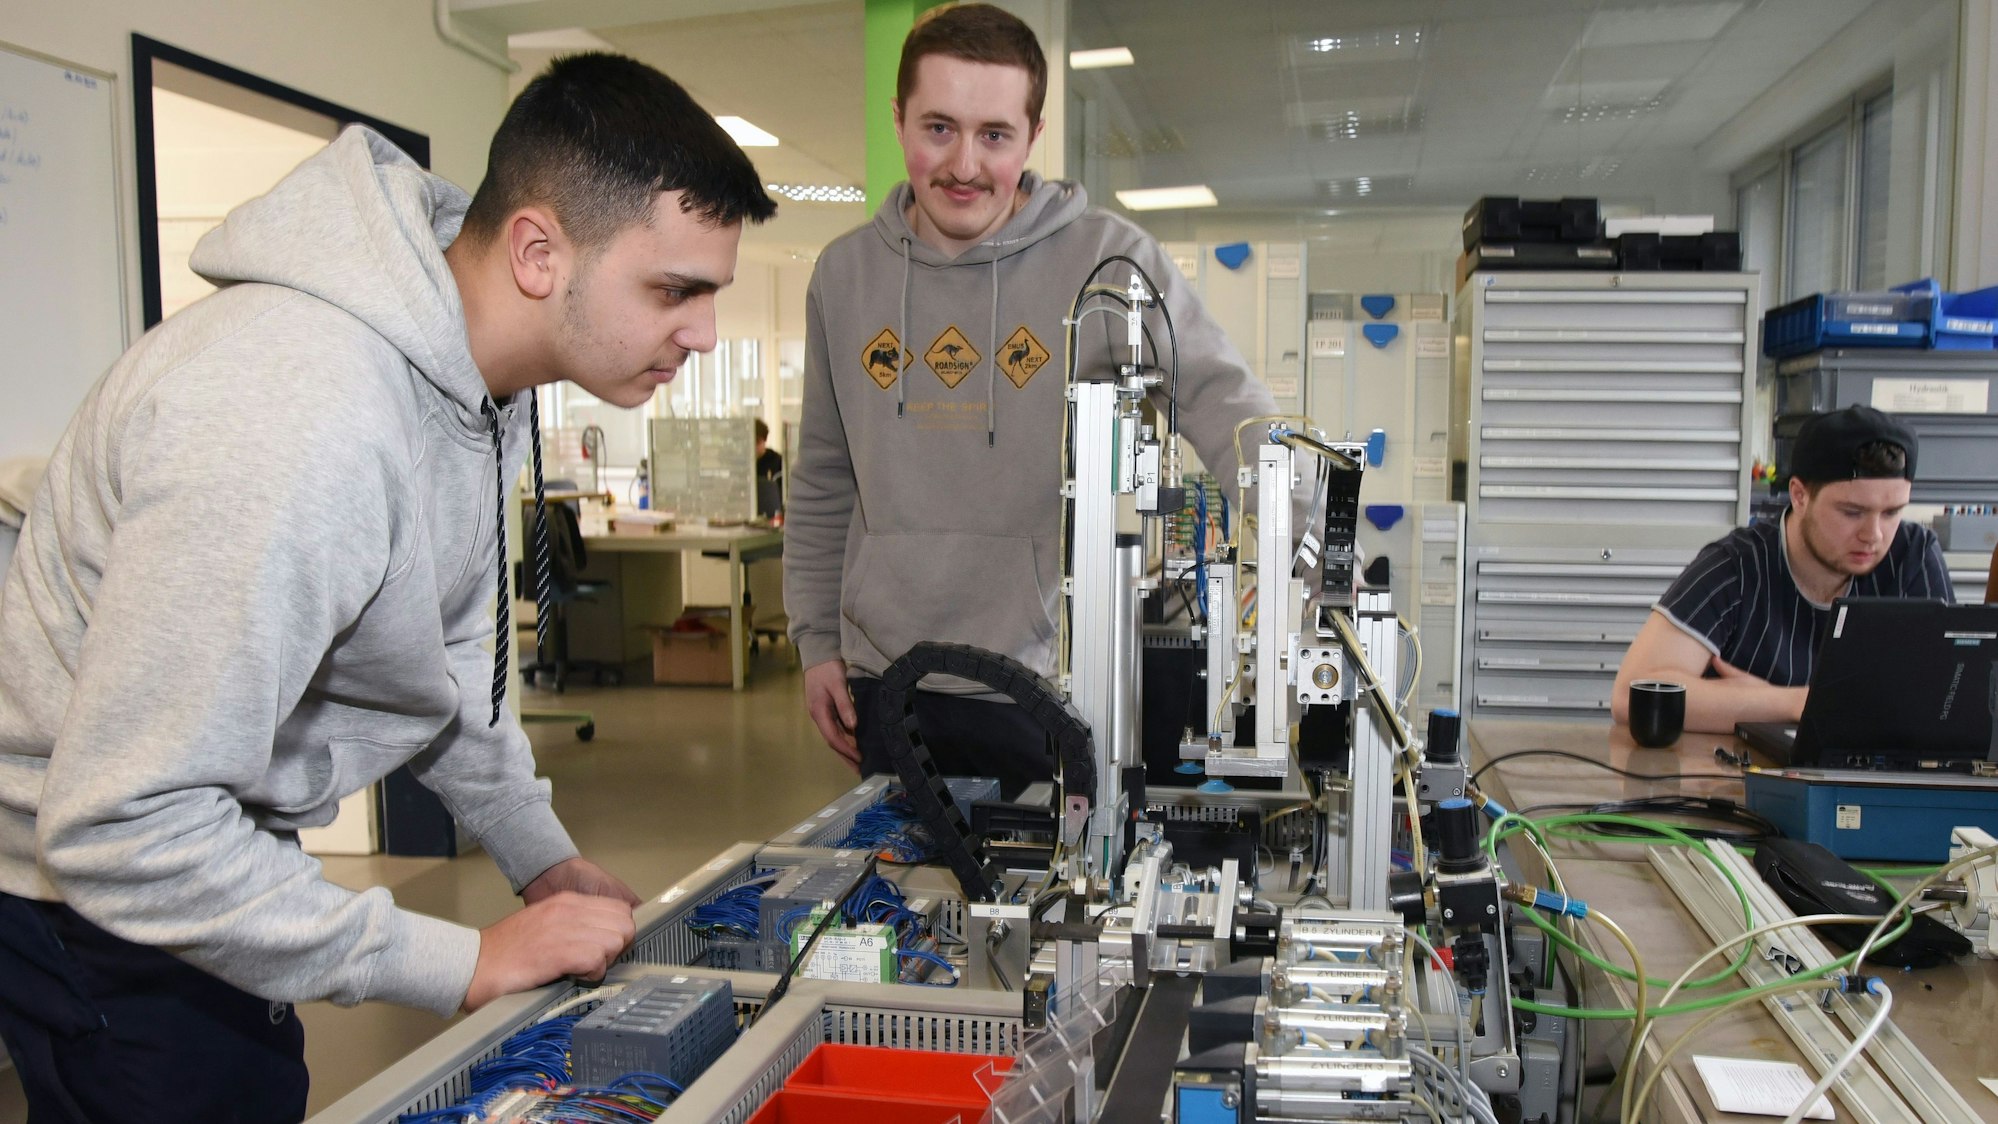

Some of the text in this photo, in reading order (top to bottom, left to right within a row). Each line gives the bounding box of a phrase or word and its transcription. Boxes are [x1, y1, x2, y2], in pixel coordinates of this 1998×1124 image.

[1146, 472, 1156, 484] P1
[1323, 927, 1373, 937] ZYLINDER
[1375, 929, 1382, 937] 4
[859, 937, 874, 947] A6
[1316, 970, 1372, 979] ZYLINDER
[1313, 1014, 1373, 1023] ZYLINDER
[1310, 1061, 1374, 1070] ZYLINDER
